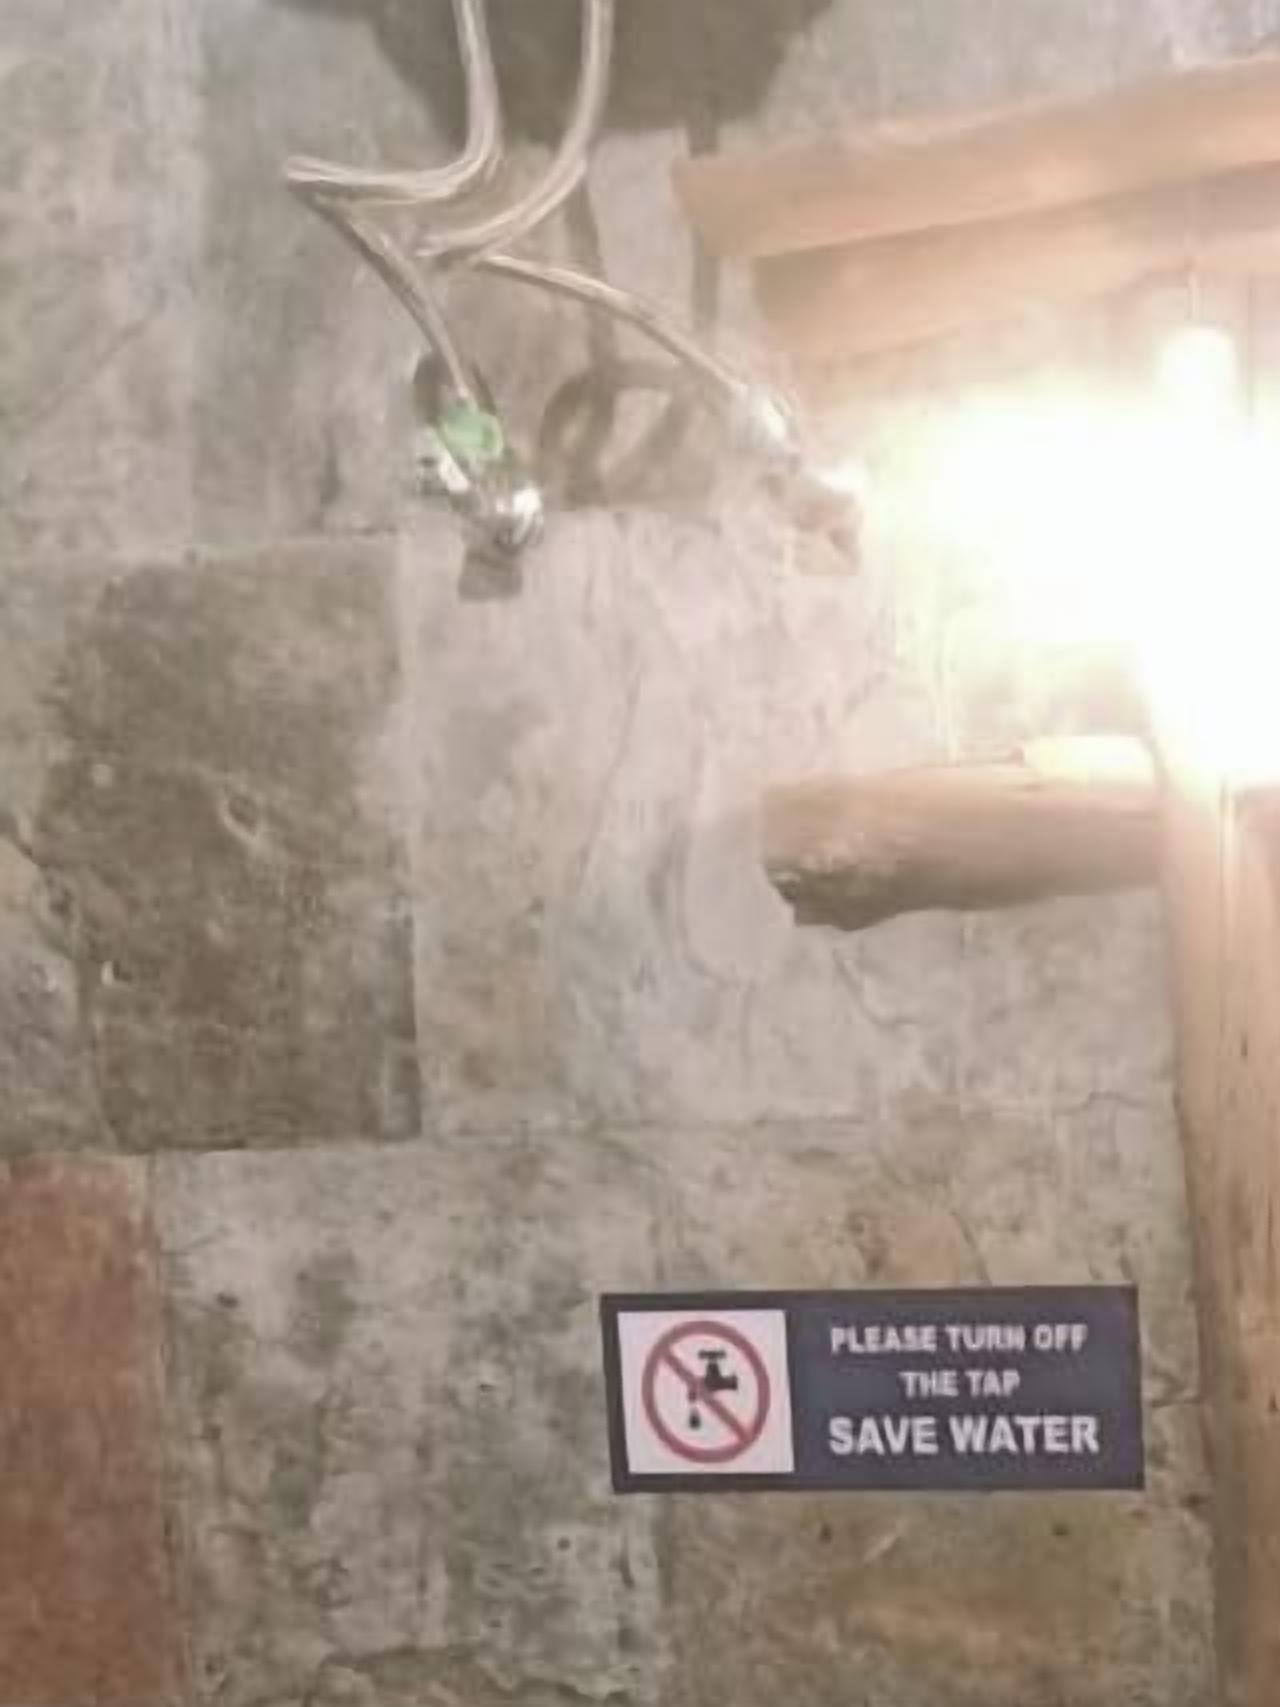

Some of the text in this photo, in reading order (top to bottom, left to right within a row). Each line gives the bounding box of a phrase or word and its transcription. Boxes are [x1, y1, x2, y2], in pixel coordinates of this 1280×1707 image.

[831, 1324, 1089, 1354] PLEASE TURN OFF
[901, 1370, 1021, 1397] THE TAP
[828, 1416, 1101, 1455] SAVE WATER
